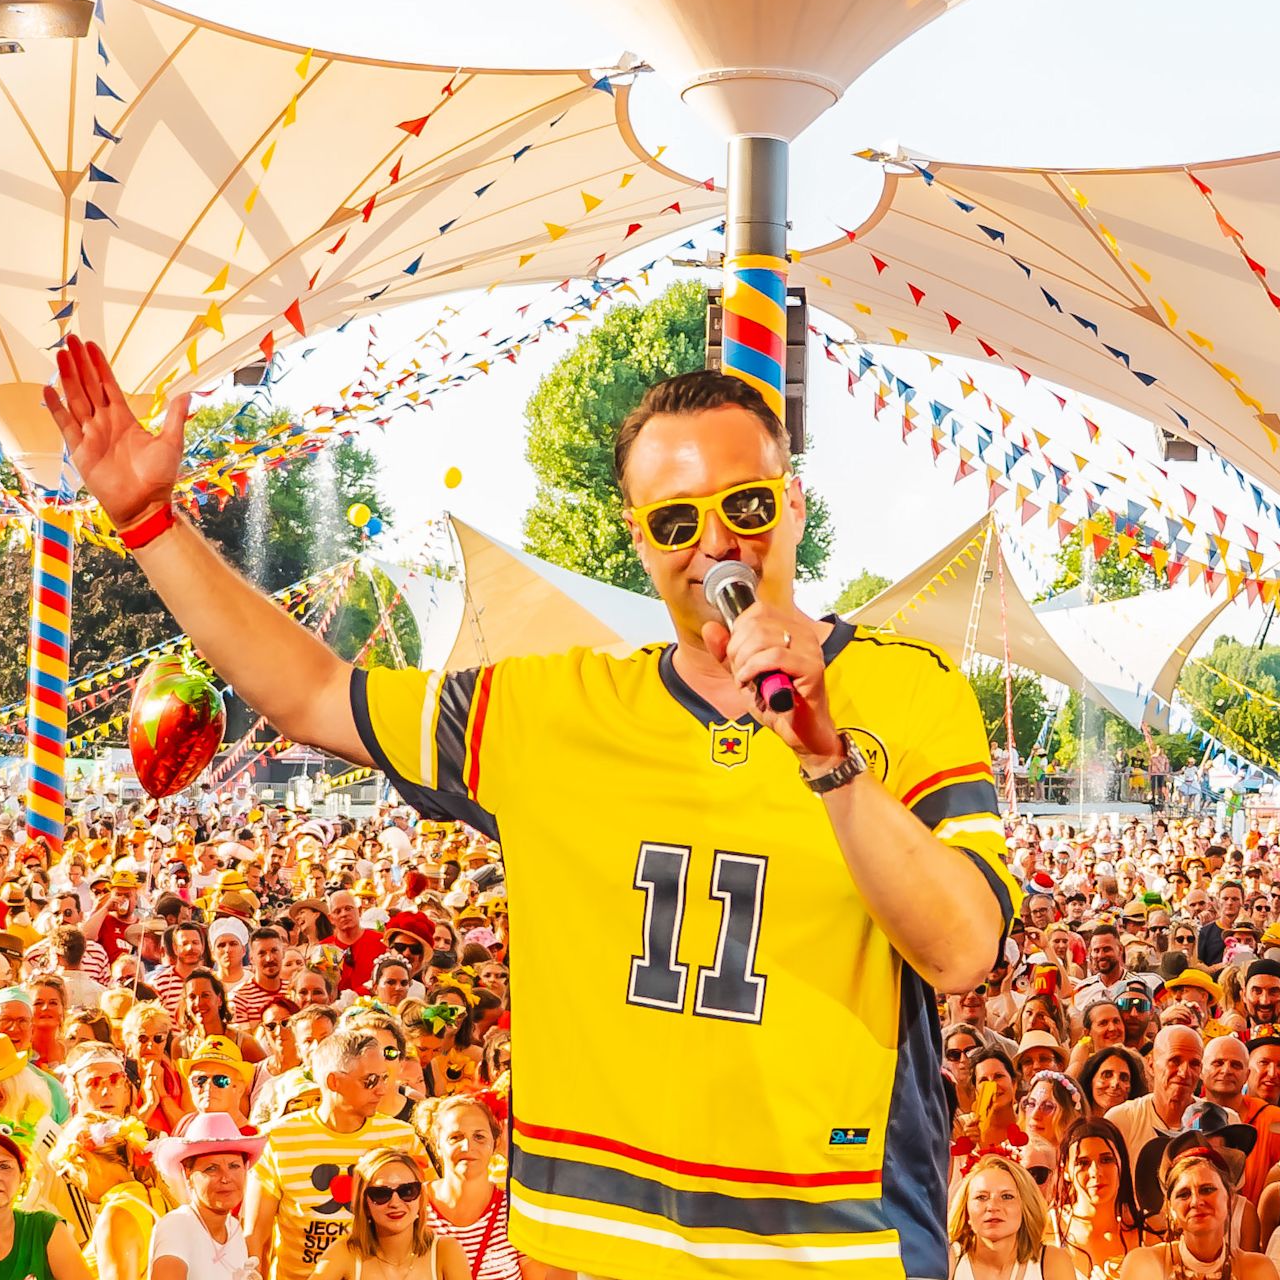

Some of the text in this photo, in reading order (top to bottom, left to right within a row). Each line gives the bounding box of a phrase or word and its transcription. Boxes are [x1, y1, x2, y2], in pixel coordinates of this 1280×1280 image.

[626, 840, 769, 1026] 11
[303, 1221, 352, 1236] JECK
[304, 1234, 337, 1251] SU
